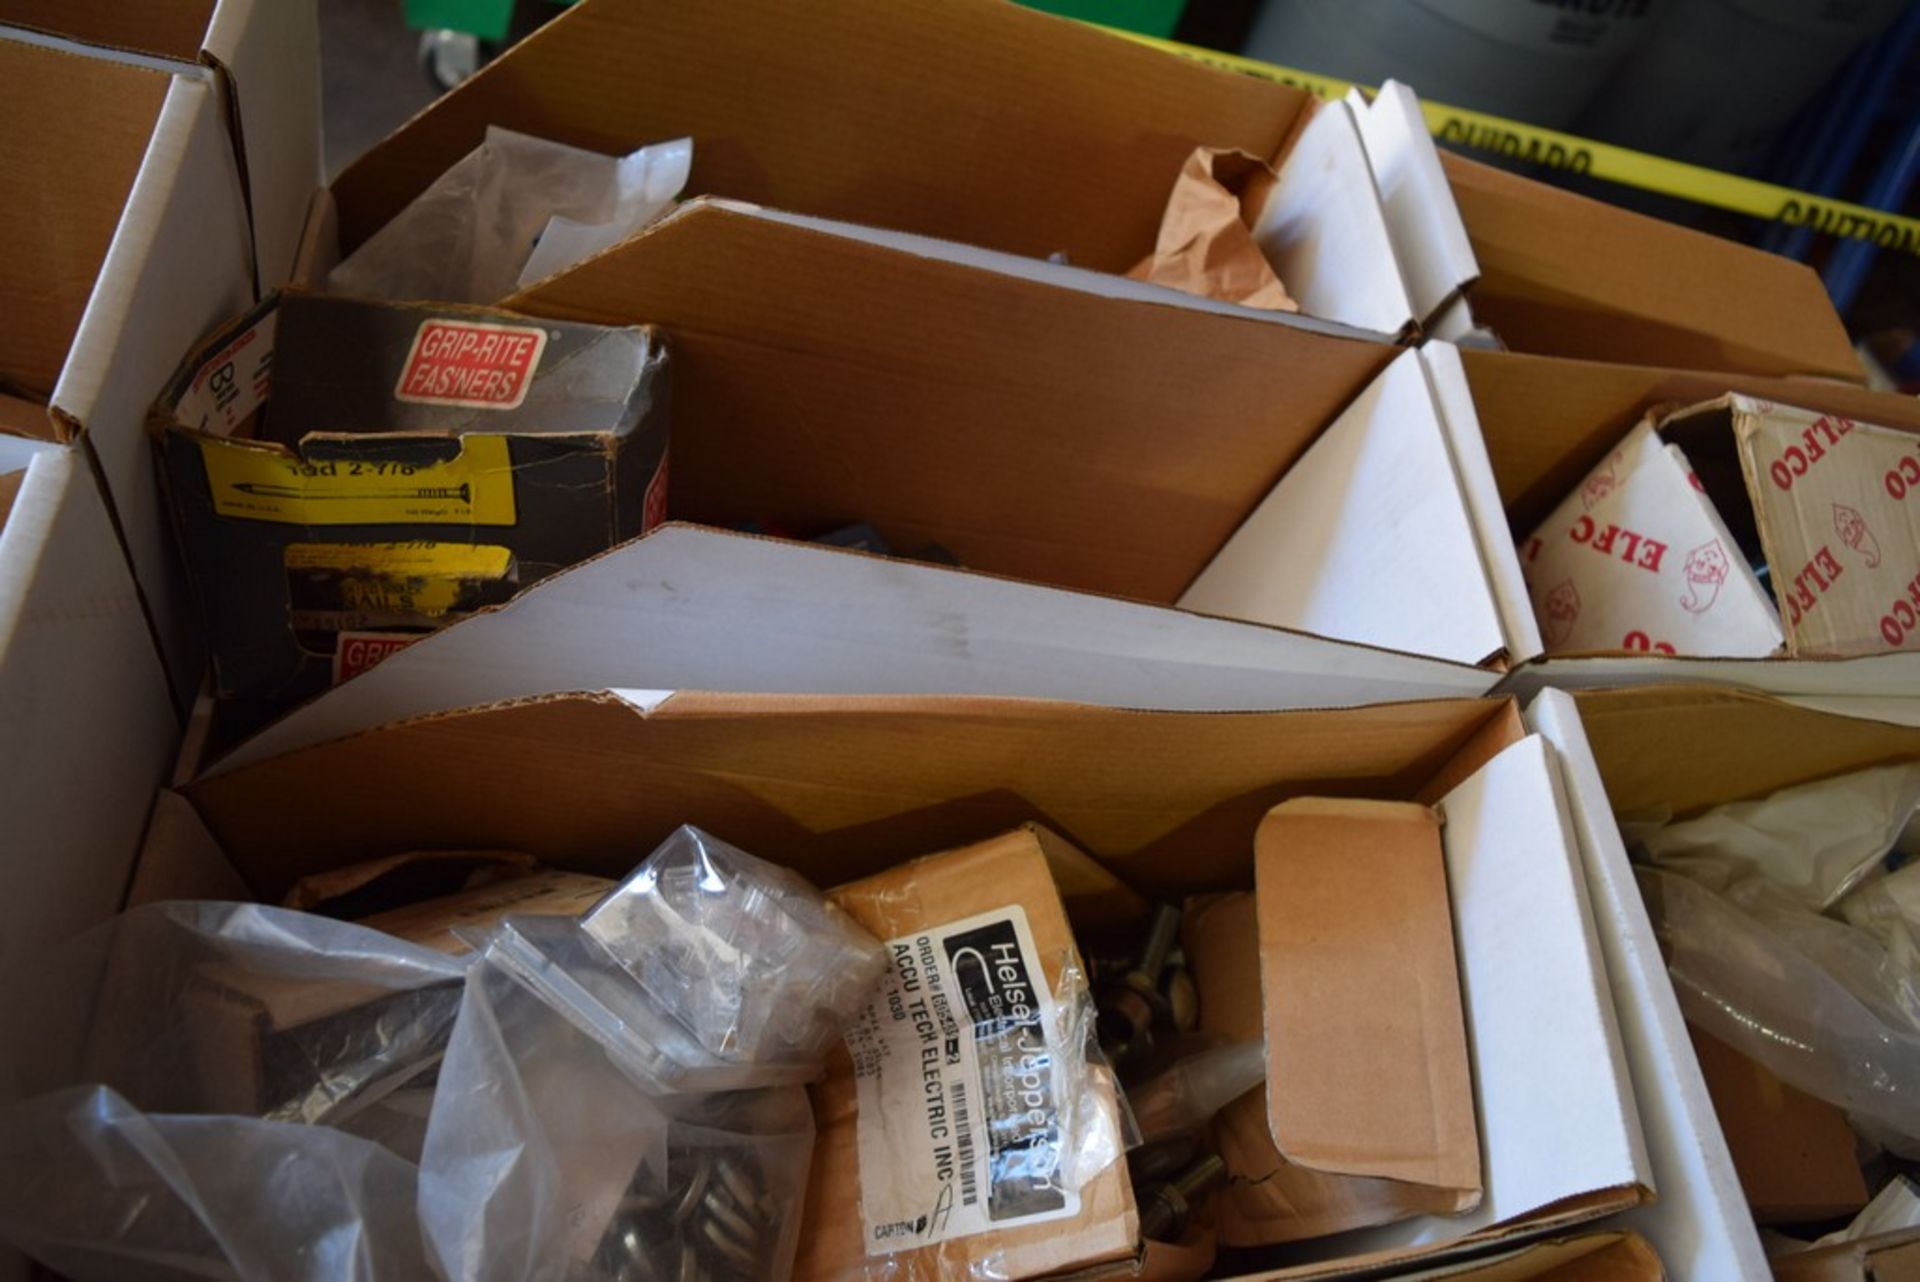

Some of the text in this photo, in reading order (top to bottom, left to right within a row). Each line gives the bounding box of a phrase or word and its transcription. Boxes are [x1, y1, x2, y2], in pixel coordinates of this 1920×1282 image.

[1440, 118, 1593, 174] CUIDADO
[422, 327, 533, 368] GRIP-RITE
[407, 363, 517, 401] FAS'NERS
[1770, 413, 1856, 491] ELFCO
[1570, 515, 1669, 573] ELFC
[916, 936, 944, 992] ORDER#
[892, 943, 953, 1181] ACCU TECH ELECTRIC INC
[990, 941, 1052, 1191] Helsel-Jepperson
[1002, 1056, 1024, 1144] Incorpored
